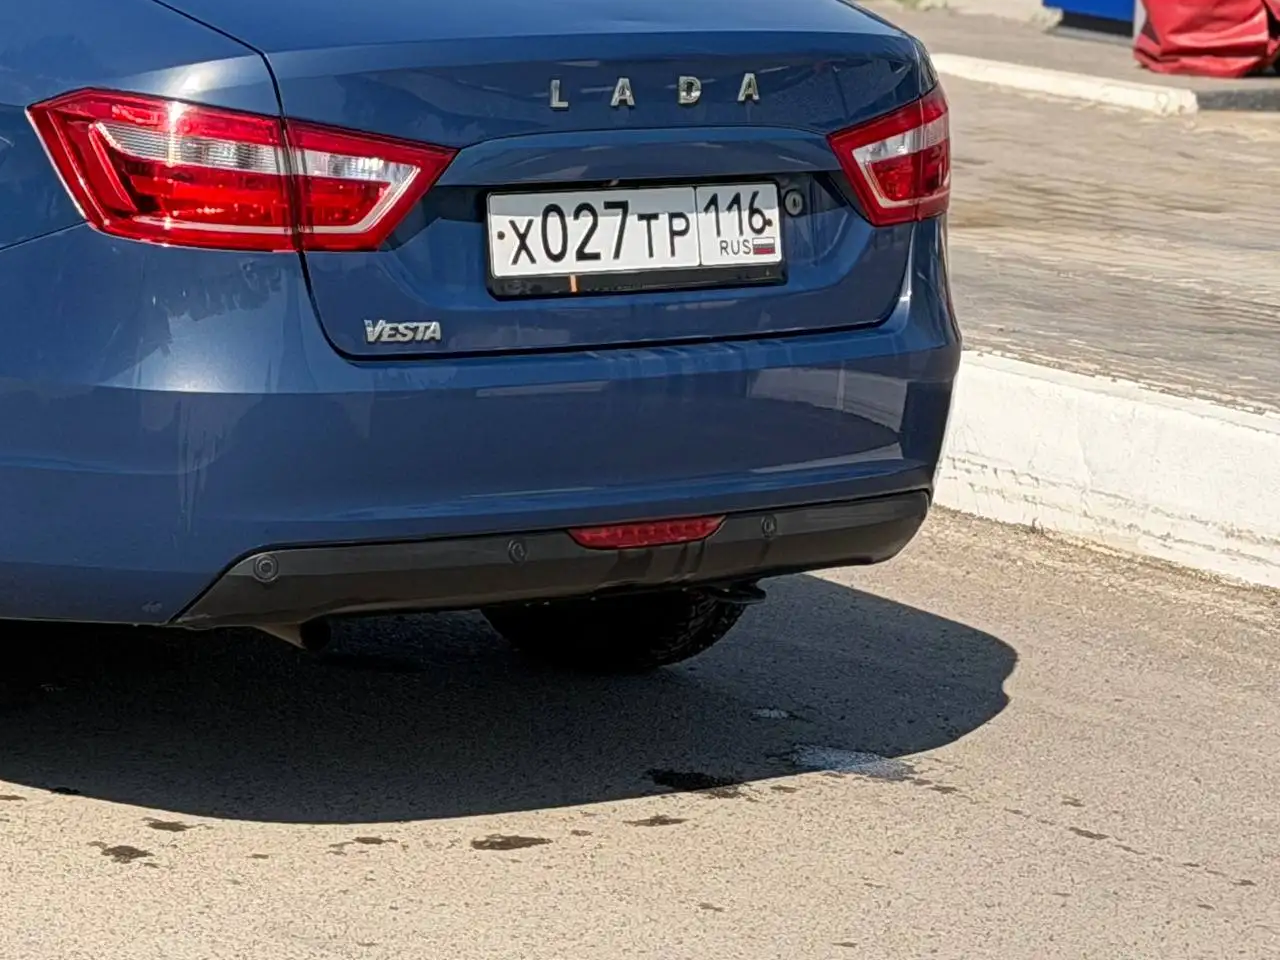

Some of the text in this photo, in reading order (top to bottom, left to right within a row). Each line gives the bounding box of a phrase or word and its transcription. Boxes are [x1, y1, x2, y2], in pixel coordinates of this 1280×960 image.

[550, 73, 760, 108] LADA
[703, 191, 767, 238] 116
[720, 239, 751, 256] RUS
